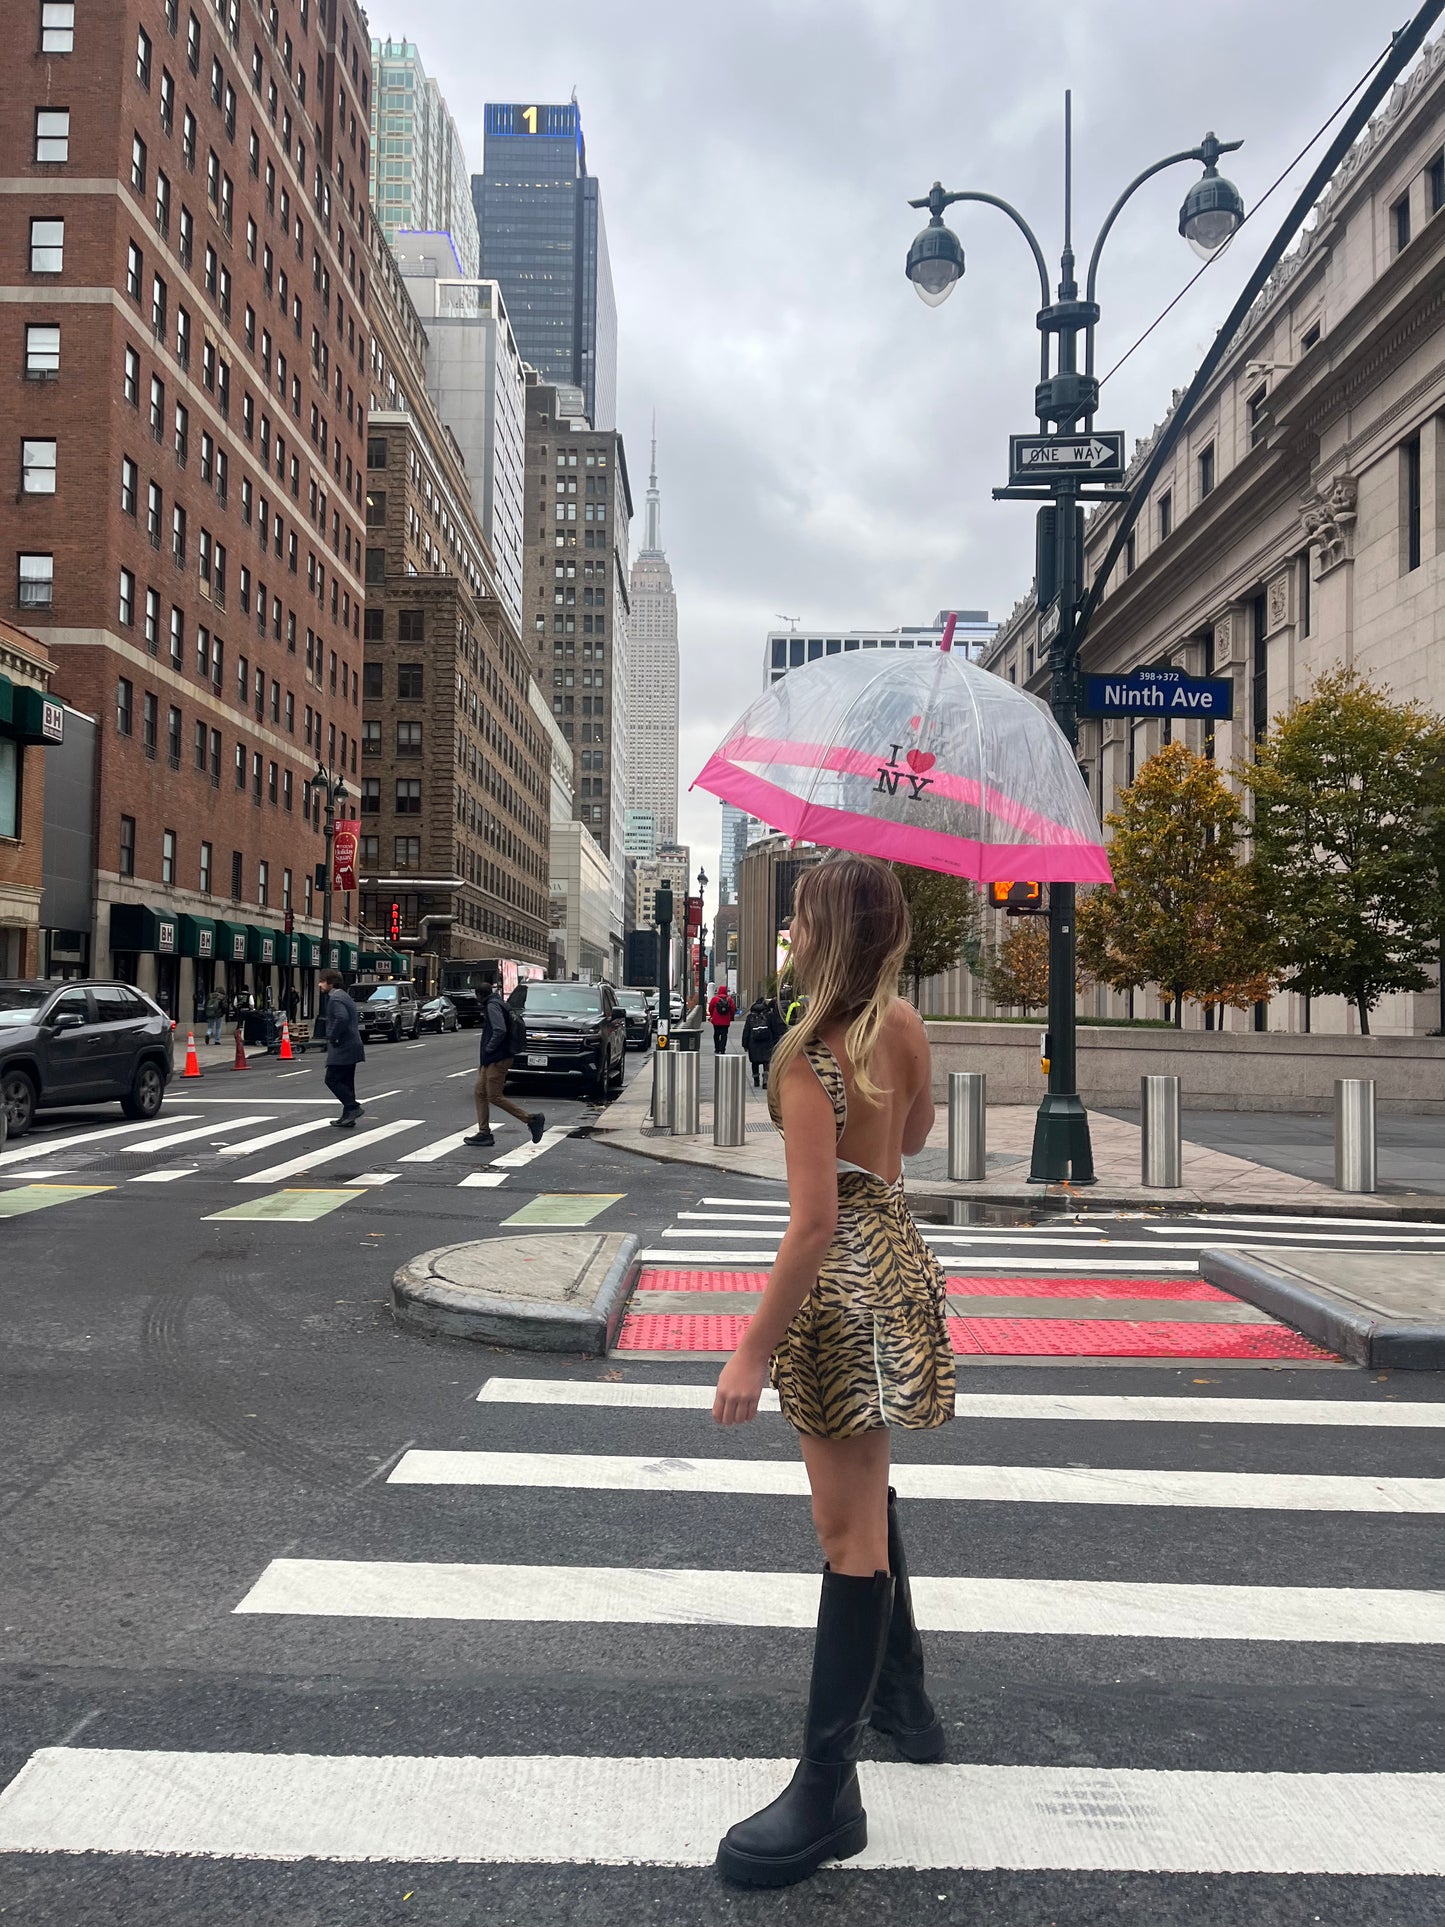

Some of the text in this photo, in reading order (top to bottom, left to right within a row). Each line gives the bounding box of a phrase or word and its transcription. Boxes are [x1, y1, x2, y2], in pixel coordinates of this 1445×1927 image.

[522, 106, 537, 134] 1
[1030, 446, 1104, 462] ONE WAY
[1105, 684, 1213, 708] Ninth Ave
[45, 706, 61, 729] BH
[885, 744, 903, 768] I
[872, 767, 934, 801] NY
[161, 926, 173, 942] BH
[201, 933, 211, 947] BH
